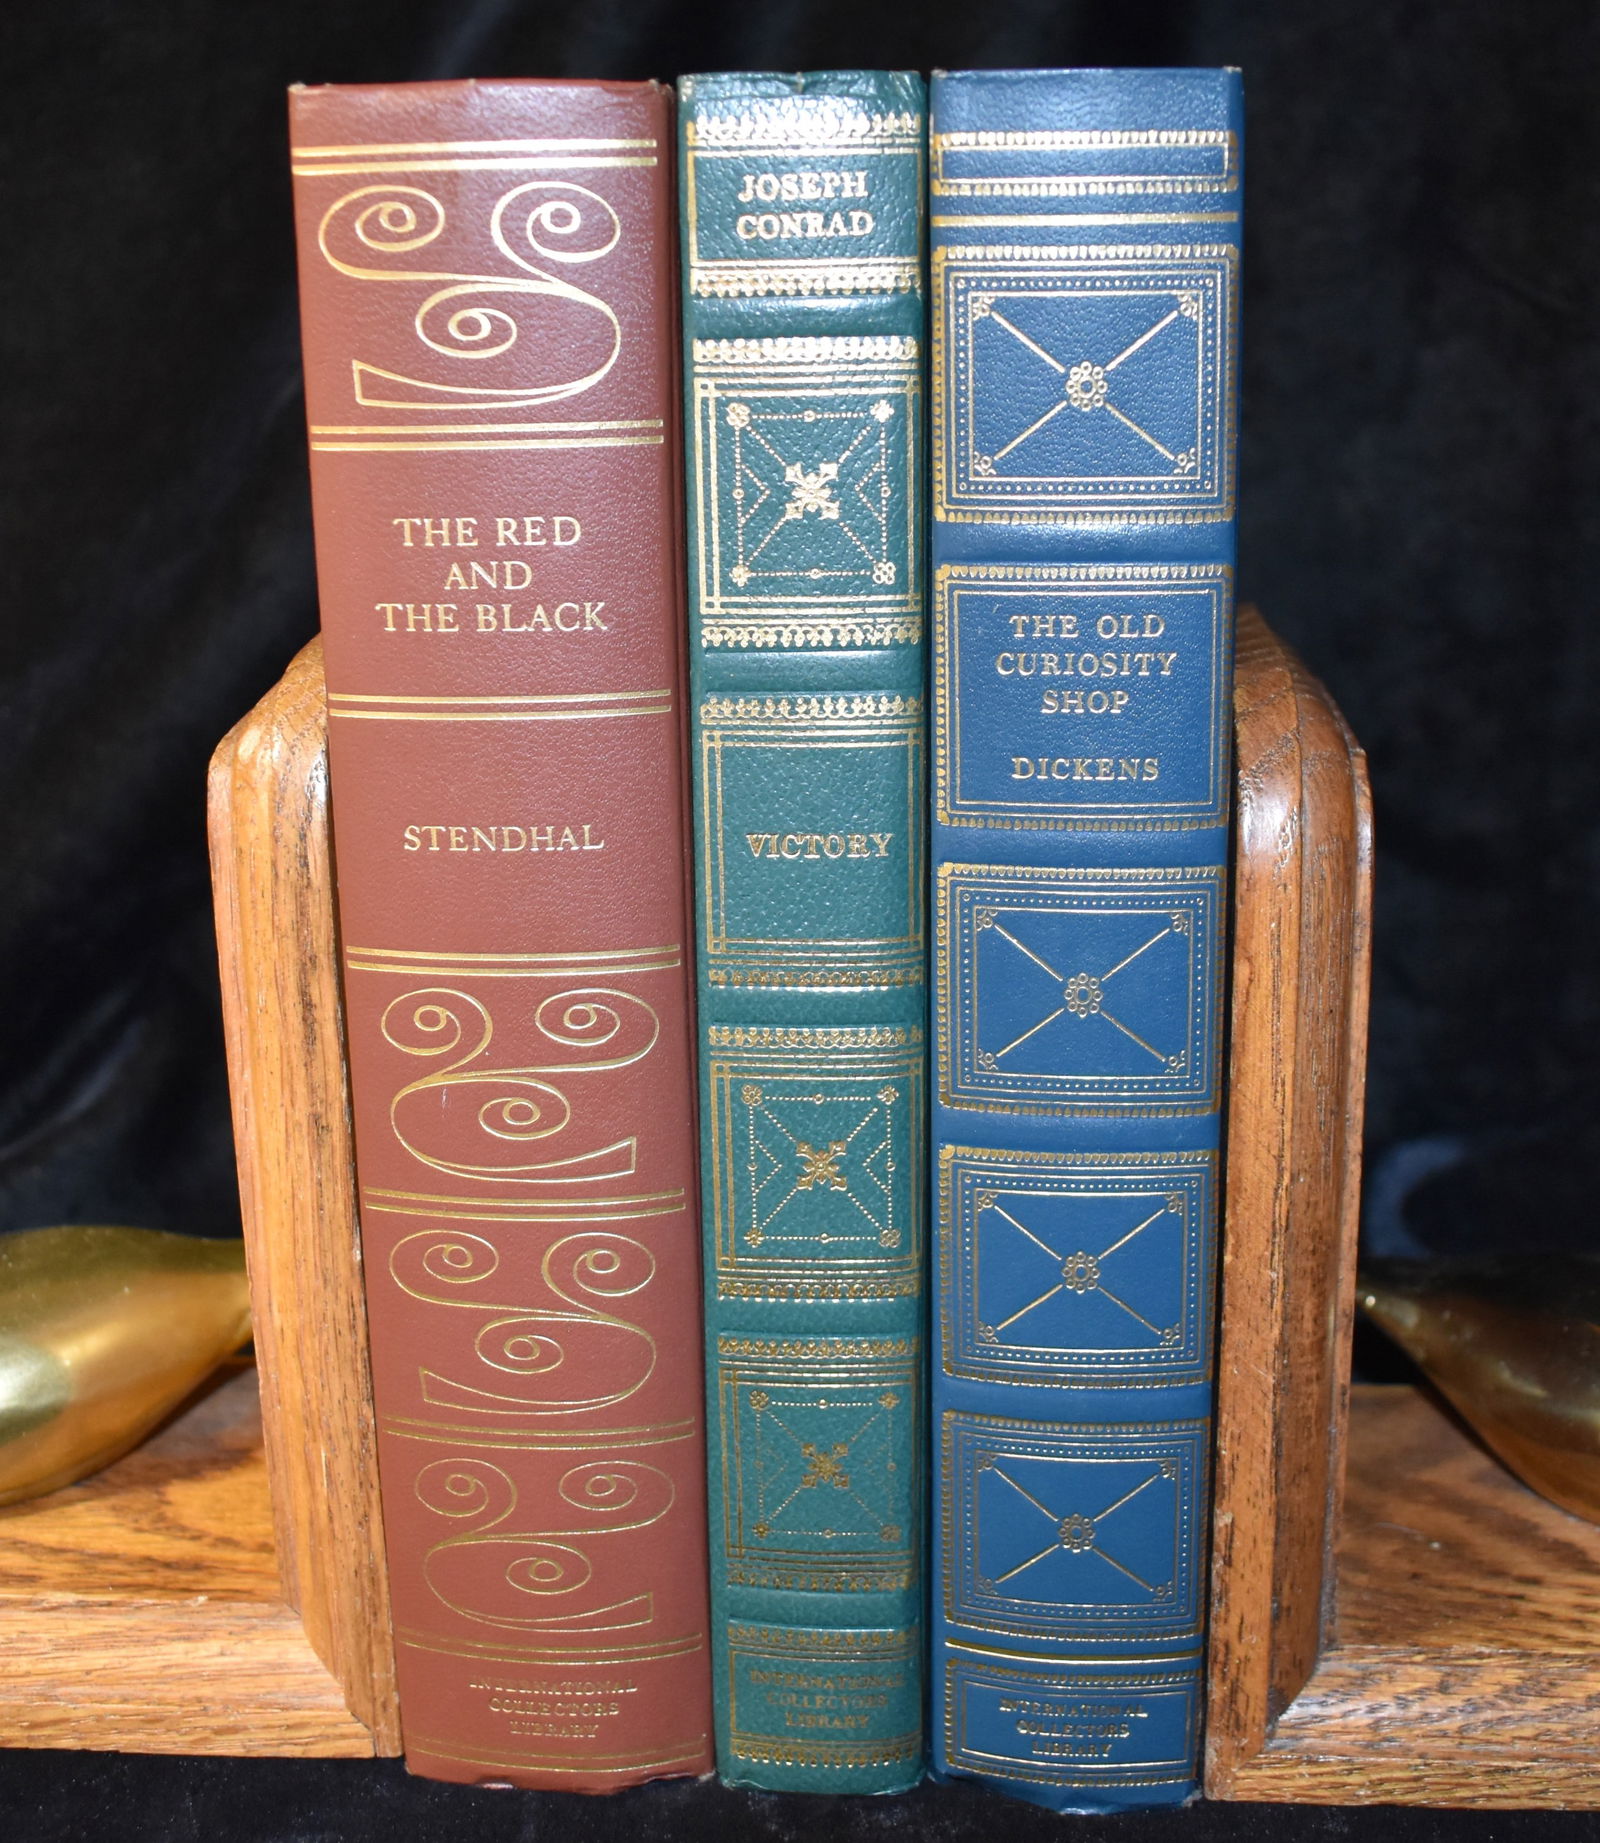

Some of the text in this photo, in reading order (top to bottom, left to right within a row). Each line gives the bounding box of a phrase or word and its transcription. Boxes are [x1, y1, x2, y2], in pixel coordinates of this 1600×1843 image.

[738, 171, 869, 202] JOSEPH
[736, 210, 874, 240] CONRAD
[393, 516, 582, 547] THE RED
[443, 561, 533, 590] AND
[374, 601, 608, 632] THE BLACK
[1009, 614, 1166, 639] THE OLD
[995, 651, 1177, 678] CURIOSITY
[1041, 689, 1129, 714] SHOP
[1010, 757, 1160, 782] DICKENS
[403, 824, 604, 852] STENDHAL
[745, 832, 895, 859] VICTORY
[489, 1698, 620, 1717] COLLECTORS
[785, 1711, 870, 1729] LIBRARY
[1016, 1720, 1130, 1738] COLLECTORS
[1031, 1741, 1113, 1758] LIBRARY
